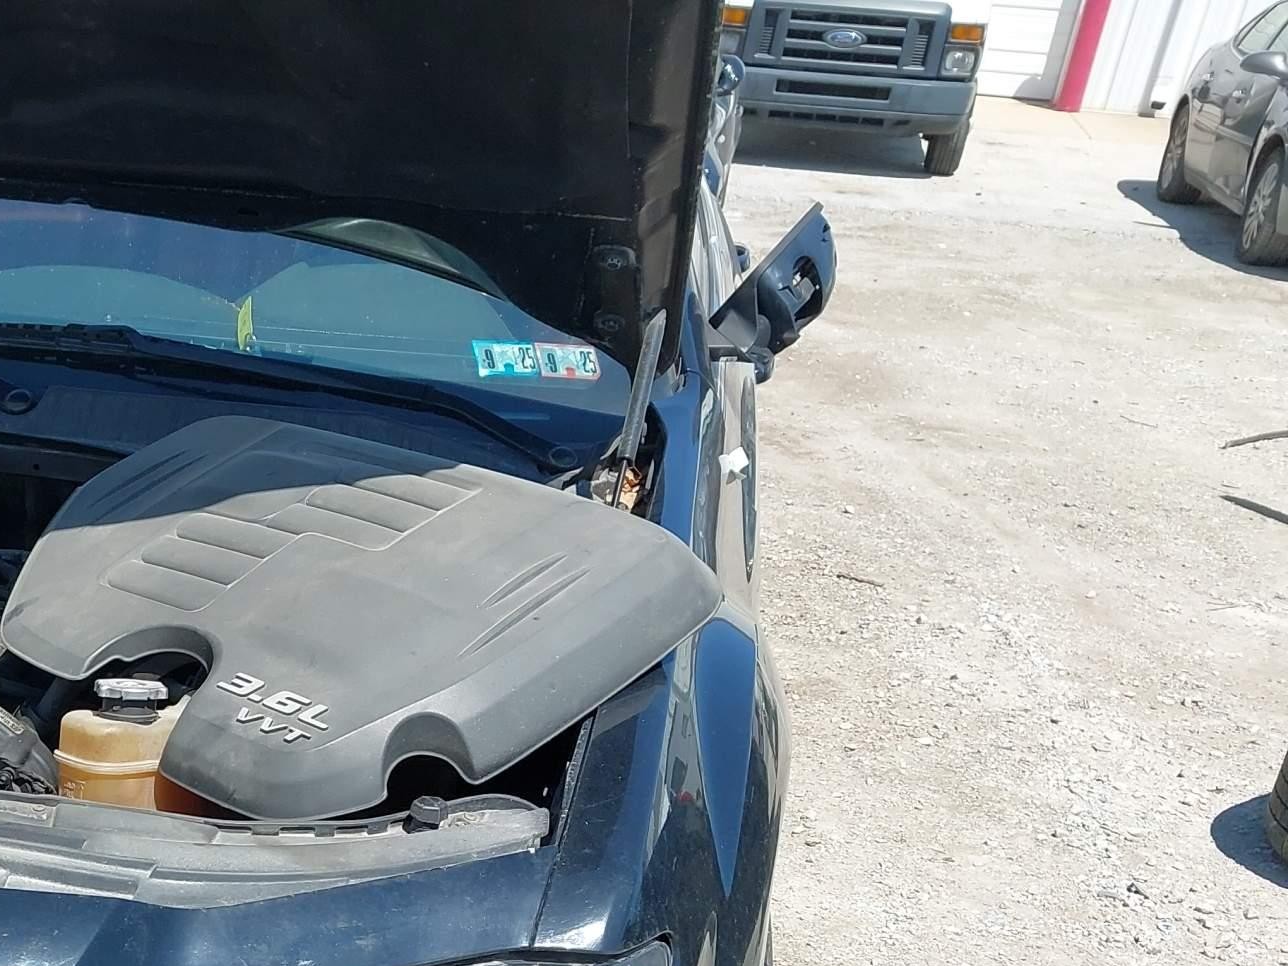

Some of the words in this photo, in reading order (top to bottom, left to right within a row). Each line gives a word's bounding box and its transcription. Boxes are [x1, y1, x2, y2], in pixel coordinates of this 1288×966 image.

[518, 347, 536, 370] 25
[579, 350, 598, 374] 25
[216, 672, 329, 731] 3.6L
[236, 706, 312, 744] VVT
